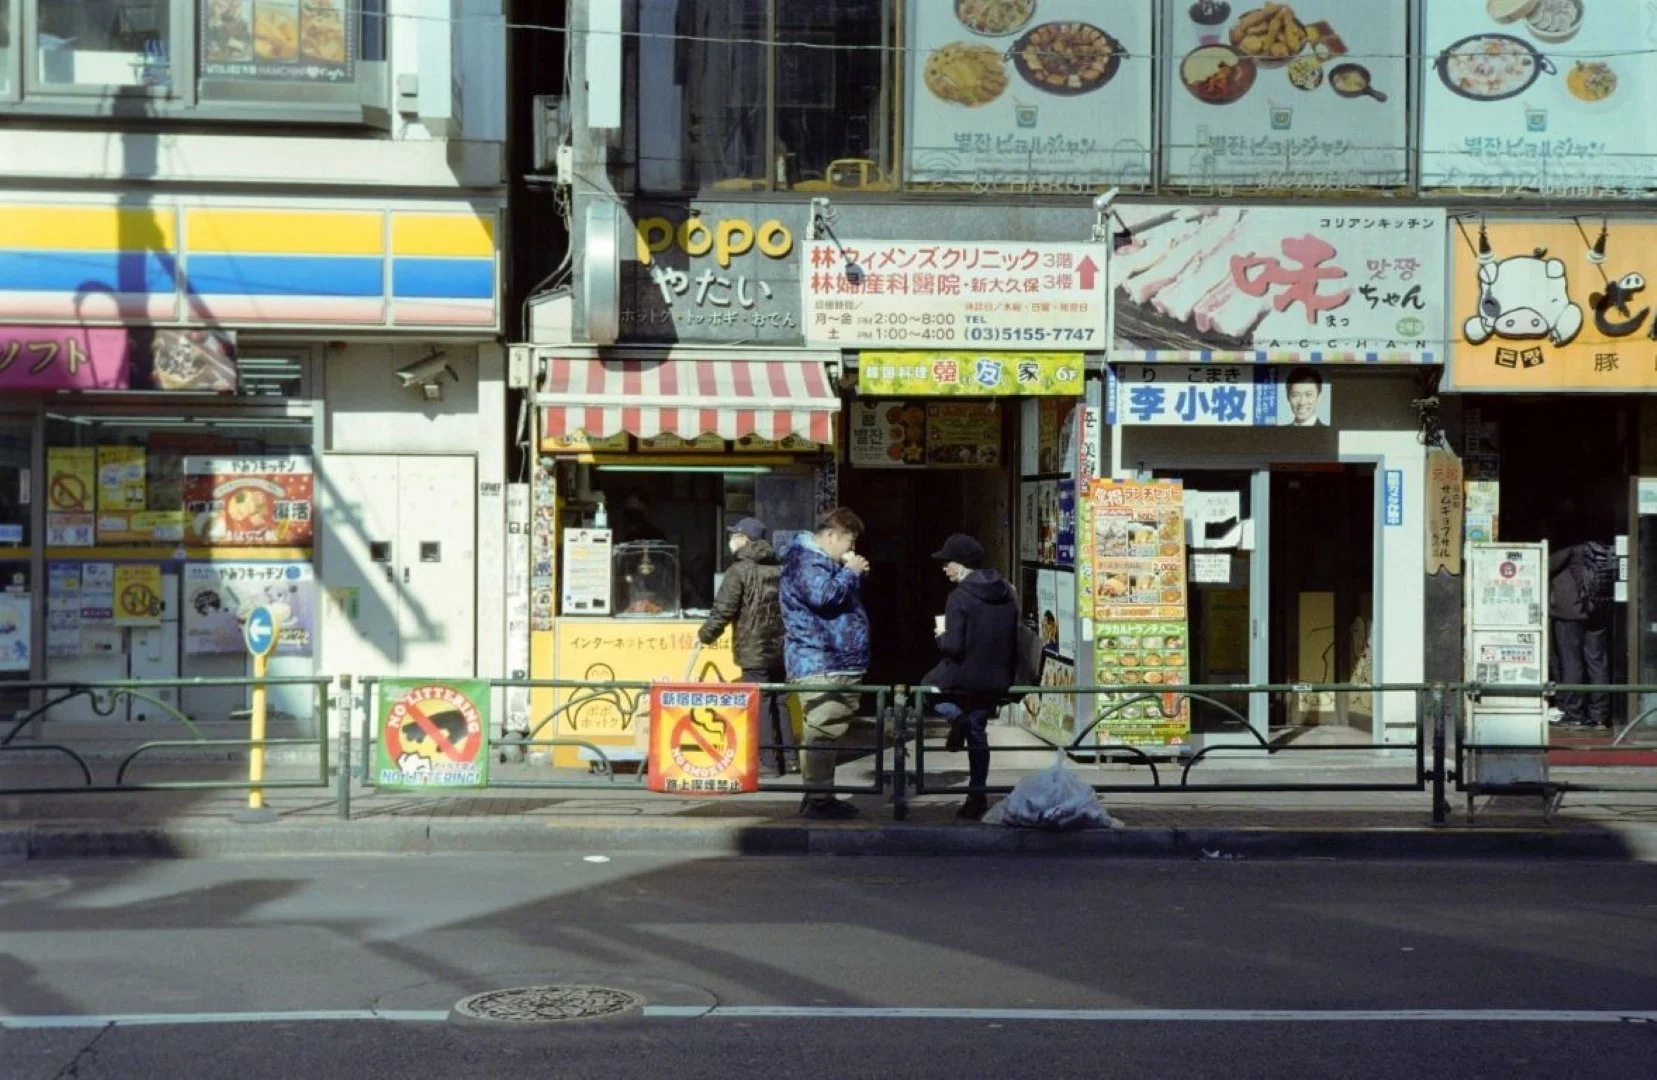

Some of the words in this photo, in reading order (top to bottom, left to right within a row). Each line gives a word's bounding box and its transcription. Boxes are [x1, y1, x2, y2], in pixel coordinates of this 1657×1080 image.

[1320, 218, 1434, 229] コリアンキッチン
[636, 217, 793, 266] popo
[811, 245, 1039, 271] 林ウィメンズクリニック
[1043, 253, 1073, 269] 3階
[651, 266, 776, 308] やたい
[1230, 234, 1353, 325] 味
[1358, 284, 1425, 309] ちゃん
[966, 316, 987, 324] TEL
[1325, 315, 1350, 327] まっ
[828, 329, 840, 339] 土
[964, 328, 1095, 341] (03)5155-7747
[1594, 353, 1619, 371] 豚
[1142, 367, 1156, 382] り
[1188, 367, 1240, 383] こまき
[1130, 386, 1164, 421] 李
[1175, 385, 1246, 422] 小牧
[663, 692, 749, 706] 新宿区内全域
[388, 703, 408, 729] NO
[406, 687, 481, 733] LITTERING
